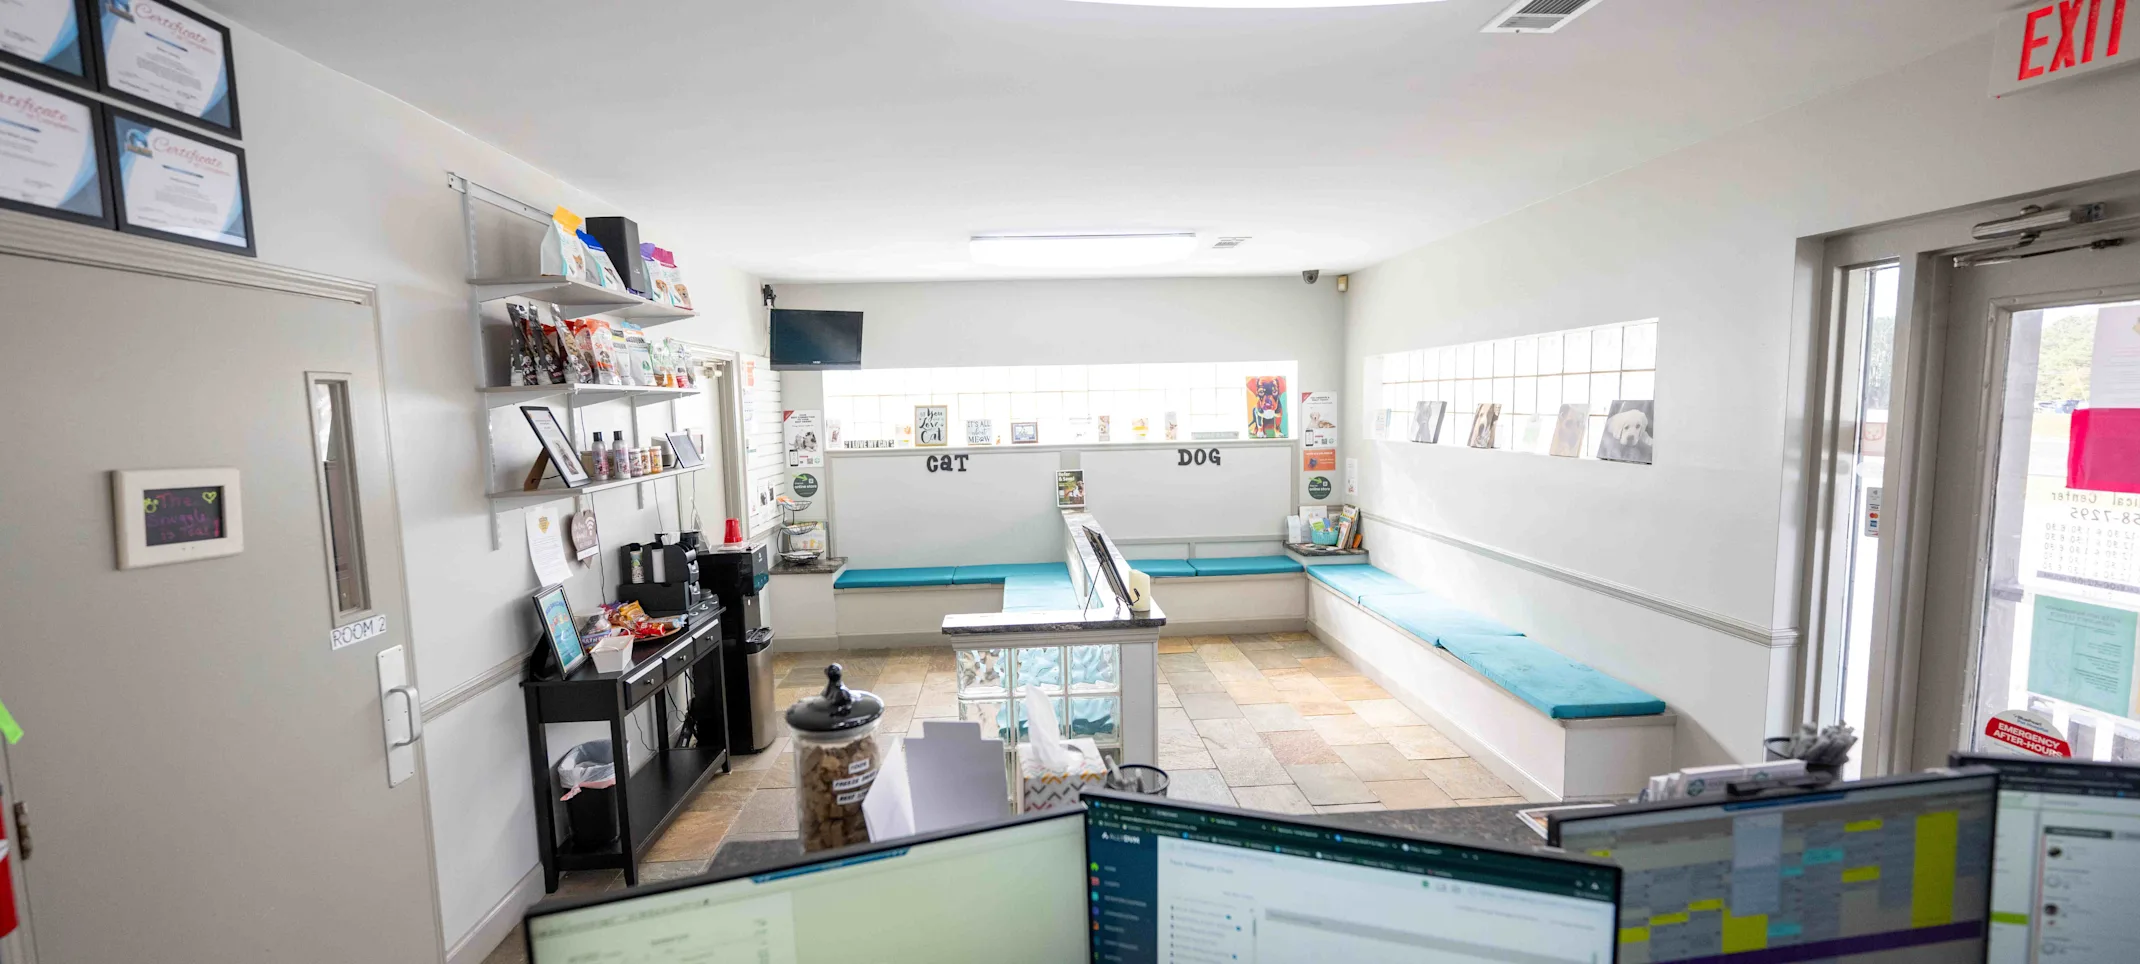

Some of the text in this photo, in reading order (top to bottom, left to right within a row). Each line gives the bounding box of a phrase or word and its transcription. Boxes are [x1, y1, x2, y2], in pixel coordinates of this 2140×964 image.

[134, 4, 208, 45] Certificate
[2018, 0, 2126, 81] EXIT
[152, 136, 223, 167] Certificate
[1178, 448, 1221, 466] DOG
[332, 616, 386, 647] ROOM 2
[1993, 730, 2063, 758] AFTER-HOURS
[1998, 722, 2060, 749] EMERGENCY
